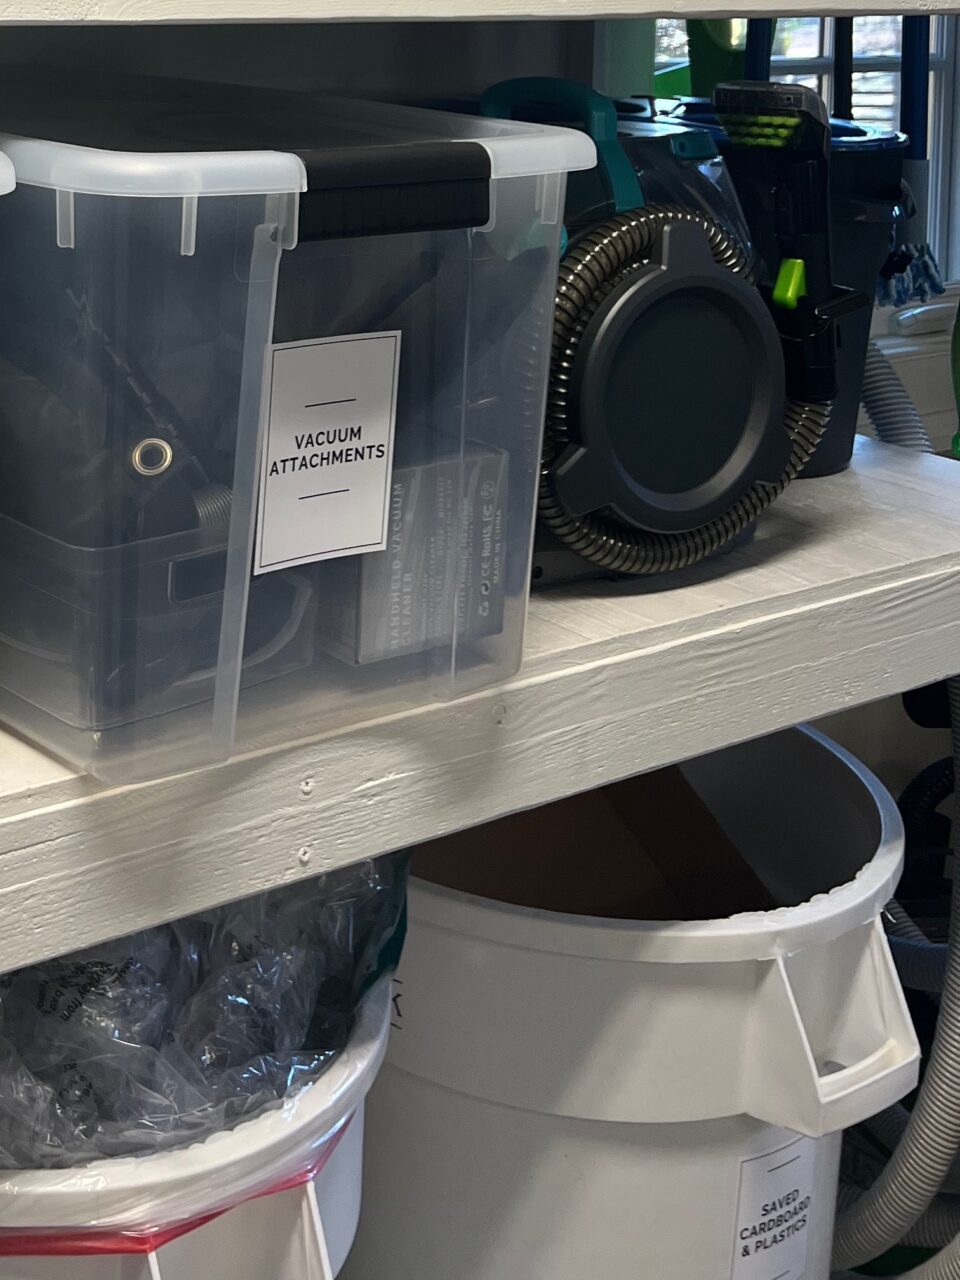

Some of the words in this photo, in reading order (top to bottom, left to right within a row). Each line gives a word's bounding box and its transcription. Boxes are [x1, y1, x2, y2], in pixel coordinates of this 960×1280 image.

[295, 426, 362, 450] VACUUM
[269, 443, 386, 476] ATTACHMENTS
[392, 483, 403, 553] VACUUM
[740, 1196, 811, 1240] CARDBOARD
[761, 1189, 800, 1217] SAVED
[741, 1245, 750, 1257] &
[754, 1215, 808, 1253] PLASTICS
